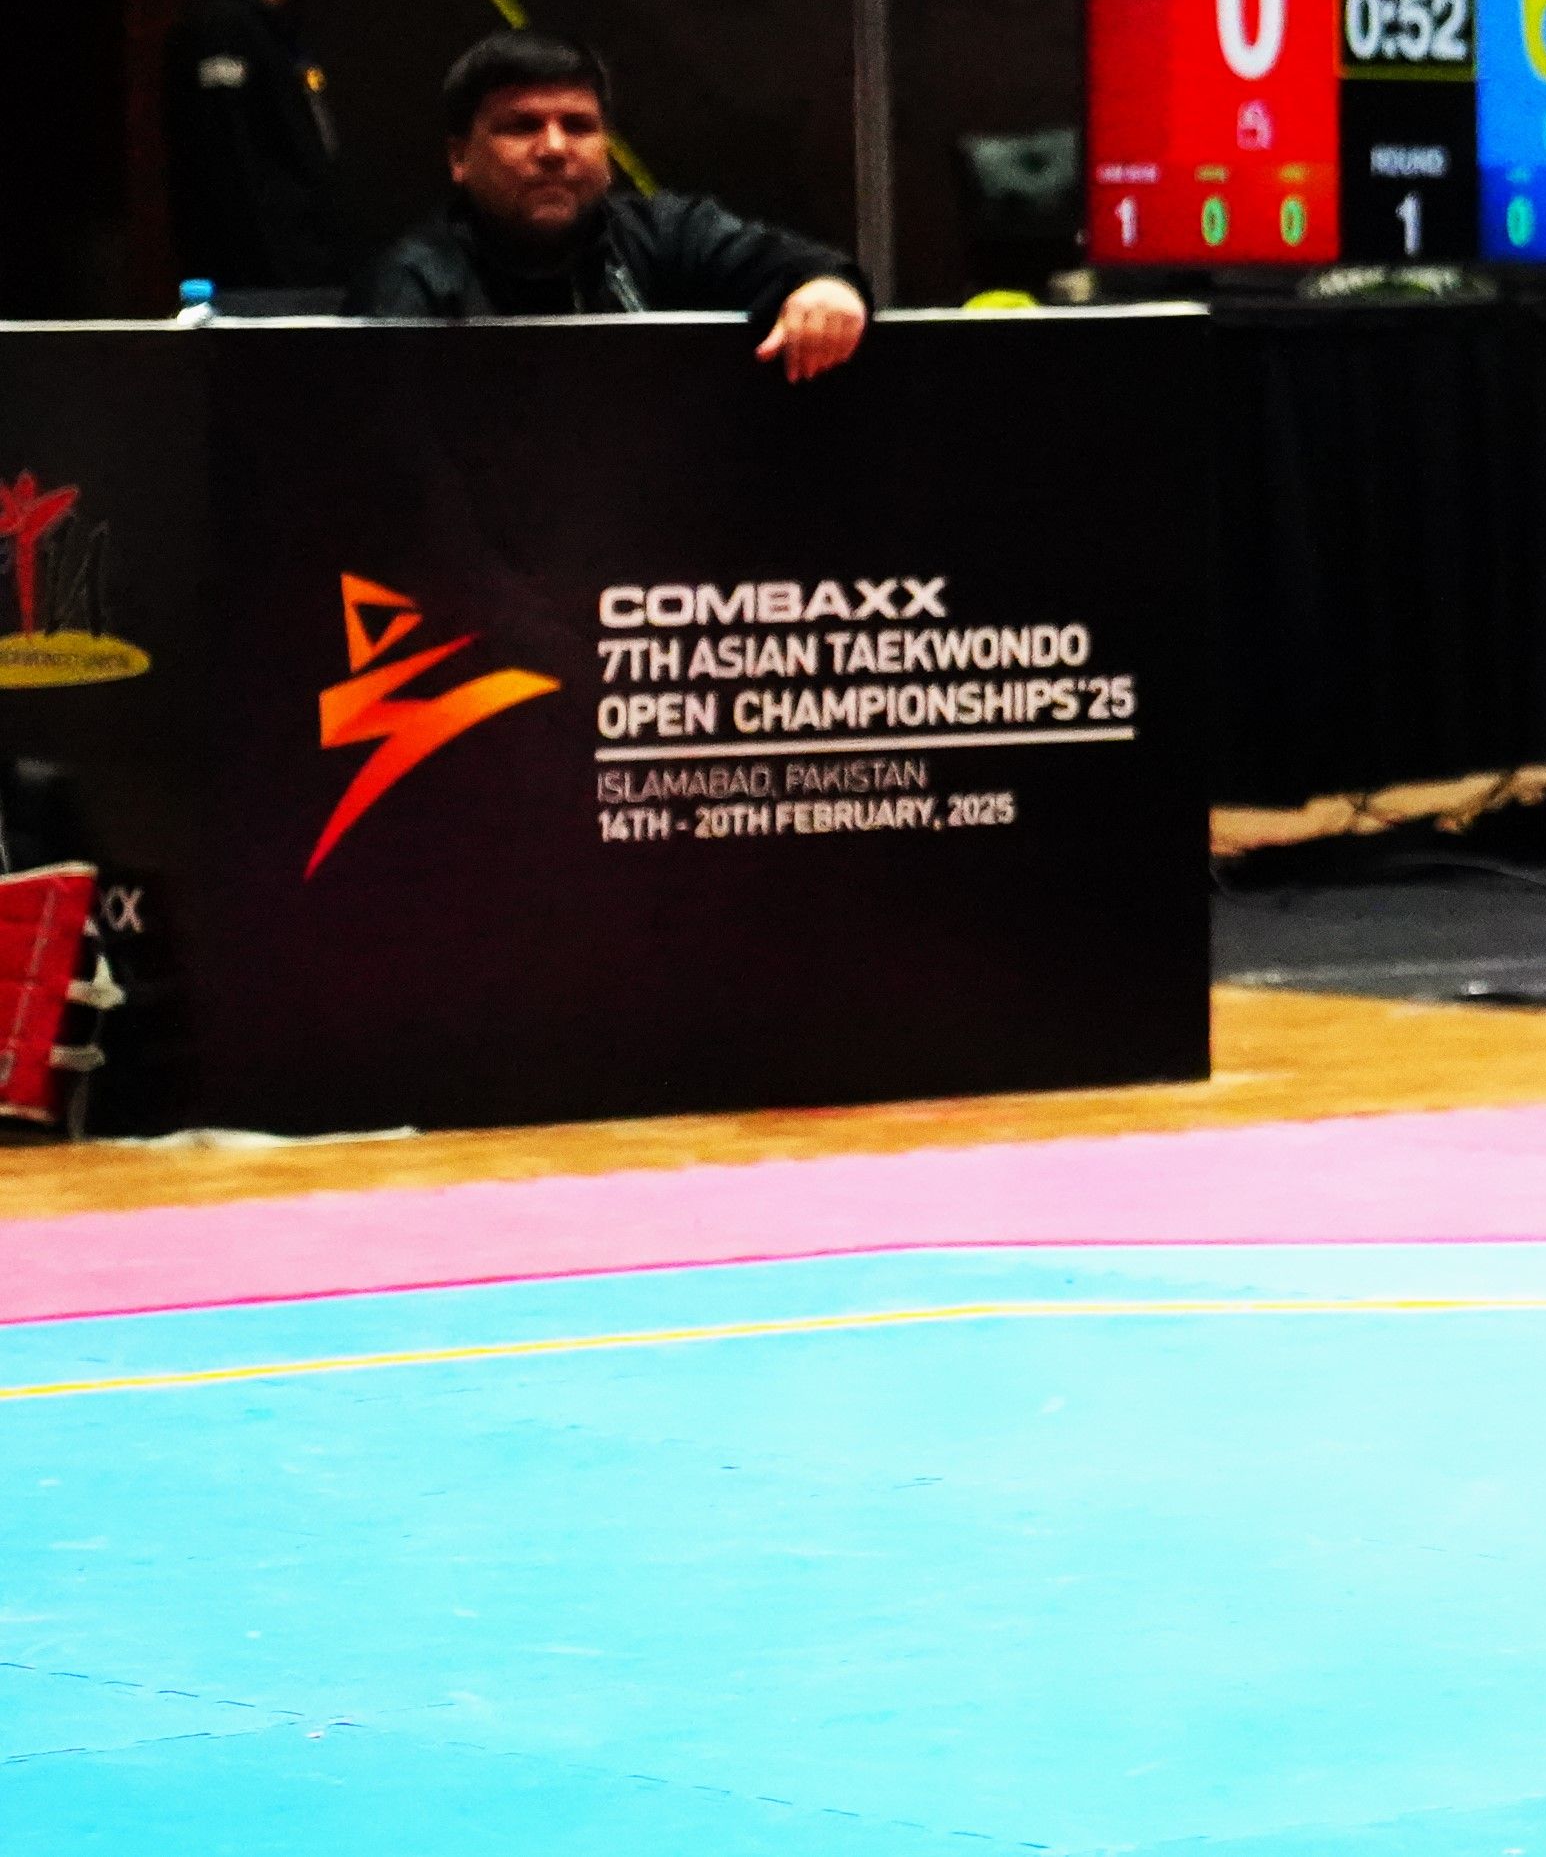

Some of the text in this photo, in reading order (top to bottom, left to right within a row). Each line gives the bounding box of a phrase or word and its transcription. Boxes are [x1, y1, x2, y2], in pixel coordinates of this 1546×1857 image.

[1114, 196, 1139, 248] 1
[1201, 196, 1230, 247] 0
[1279, 195, 1307, 247] 0
[1396, 192, 1422, 256] 1
[1507, 195, 1534, 247] 0
[598, 576, 950, 629] COMBAXX
[599, 622, 1091, 684] 7TH ASIAN TAEKWONDO
[597, 691, 718, 740] OPEN
[785, 757, 929, 795] PAKISTAN
[693, 804, 771, 840] 20TH
[775, 795, 943, 835] FEBRUARY,
[946, 791, 1017, 828] 2025
